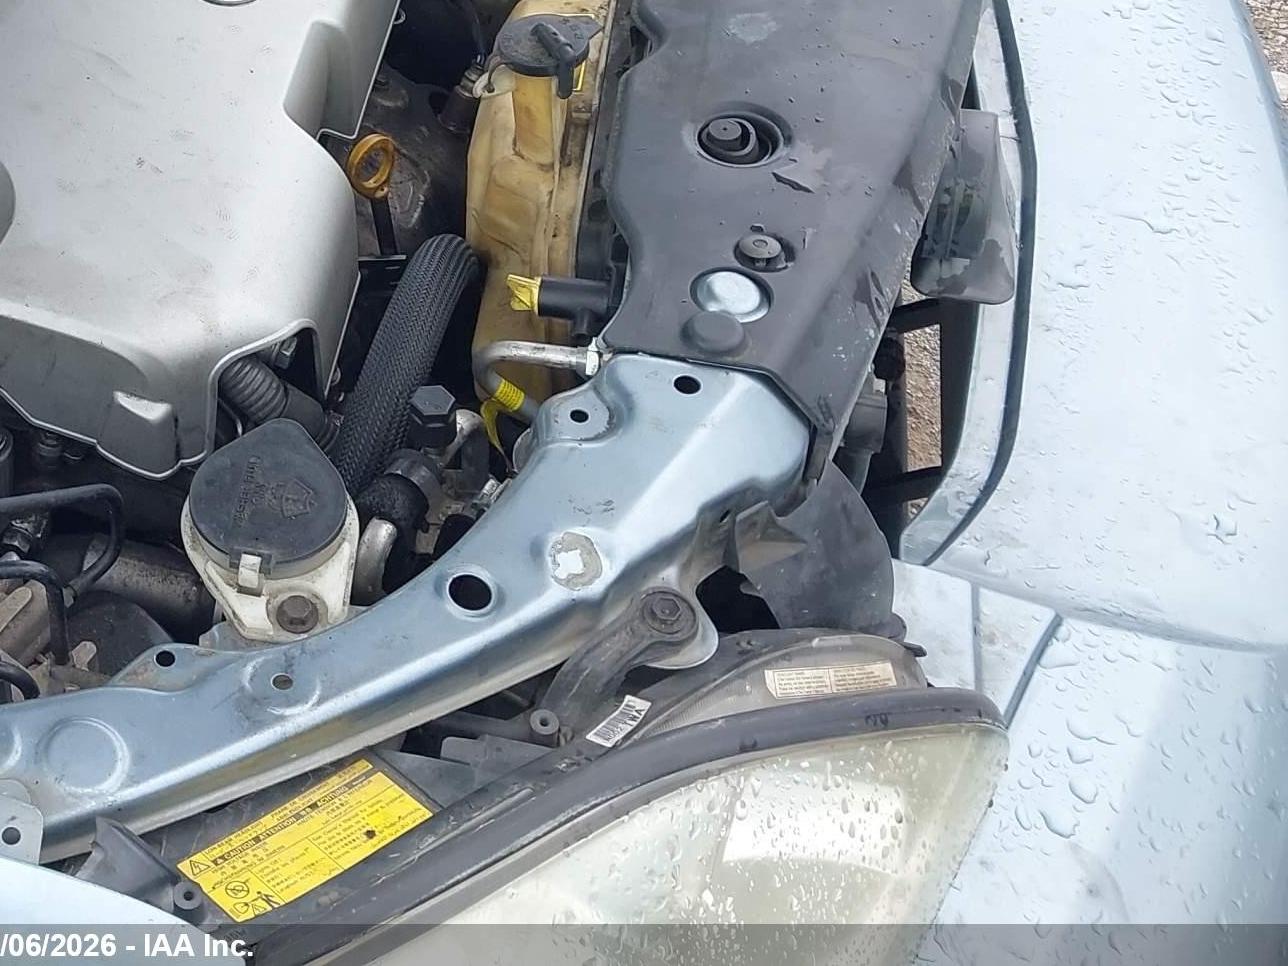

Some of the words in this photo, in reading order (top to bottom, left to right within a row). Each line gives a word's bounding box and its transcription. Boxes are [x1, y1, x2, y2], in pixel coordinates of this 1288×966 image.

[224, 839, 256, 861] CAUTION
[258, 816, 297, 841] ATTENTION
[316, 785, 349, 807] ACHTUNG
